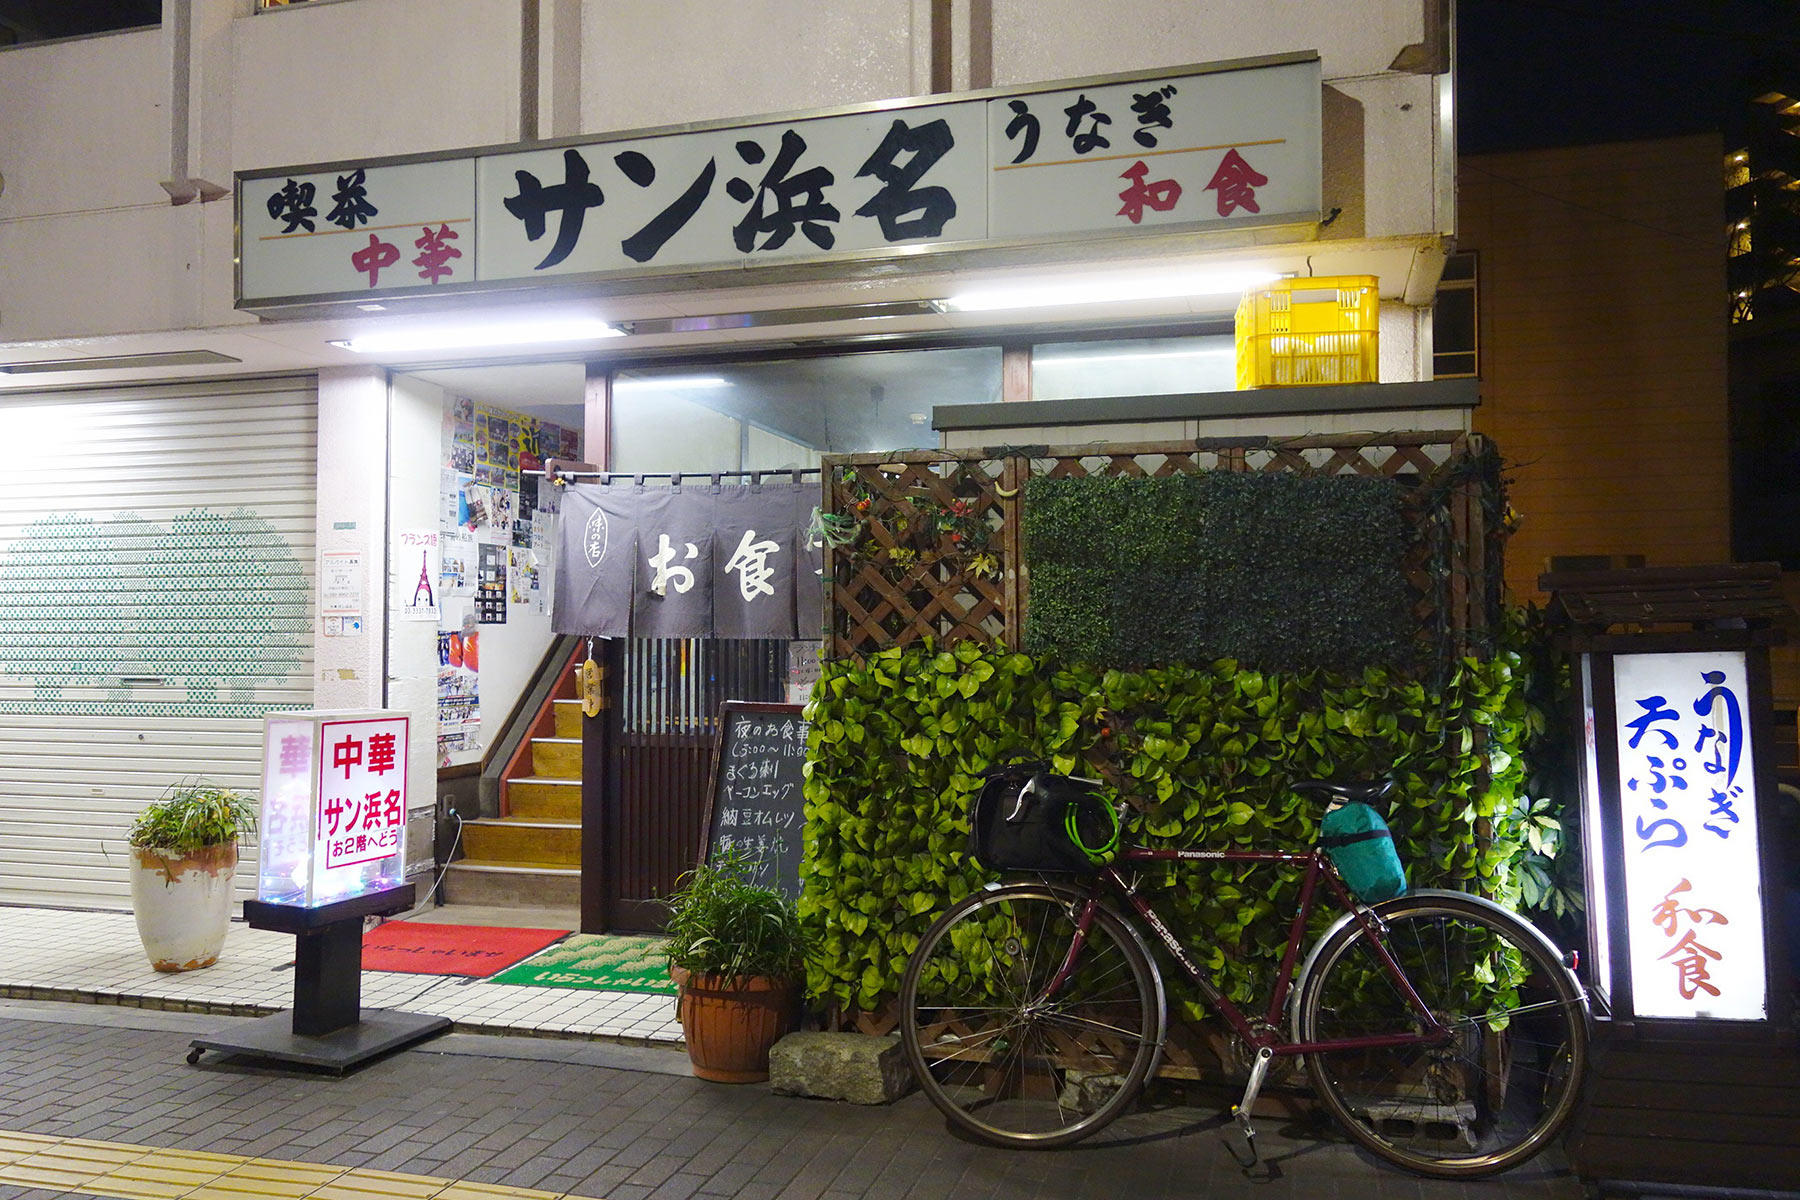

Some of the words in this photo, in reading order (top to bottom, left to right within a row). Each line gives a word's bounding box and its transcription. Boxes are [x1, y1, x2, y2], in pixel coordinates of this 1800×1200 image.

[1005, 85, 1177, 164] うなぎ
[267, 168, 379, 233] 喫茶
[503, 118, 957, 270] サン浜名
[1115, 147, 1269, 224] 和食
[351, 223, 463, 288] 中華
[648, 530, 823, 603] お食
[333, 732, 396, 780] 中華
[1624, 695, 1689, 853] 天ぷら
[1693, 670, 1744, 839] うなぎ
[324, 788, 401, 837] サン浜名
[1177, 850, 1226, 859] Panasonic
[1651, 877, 1729, 1001] 和食
